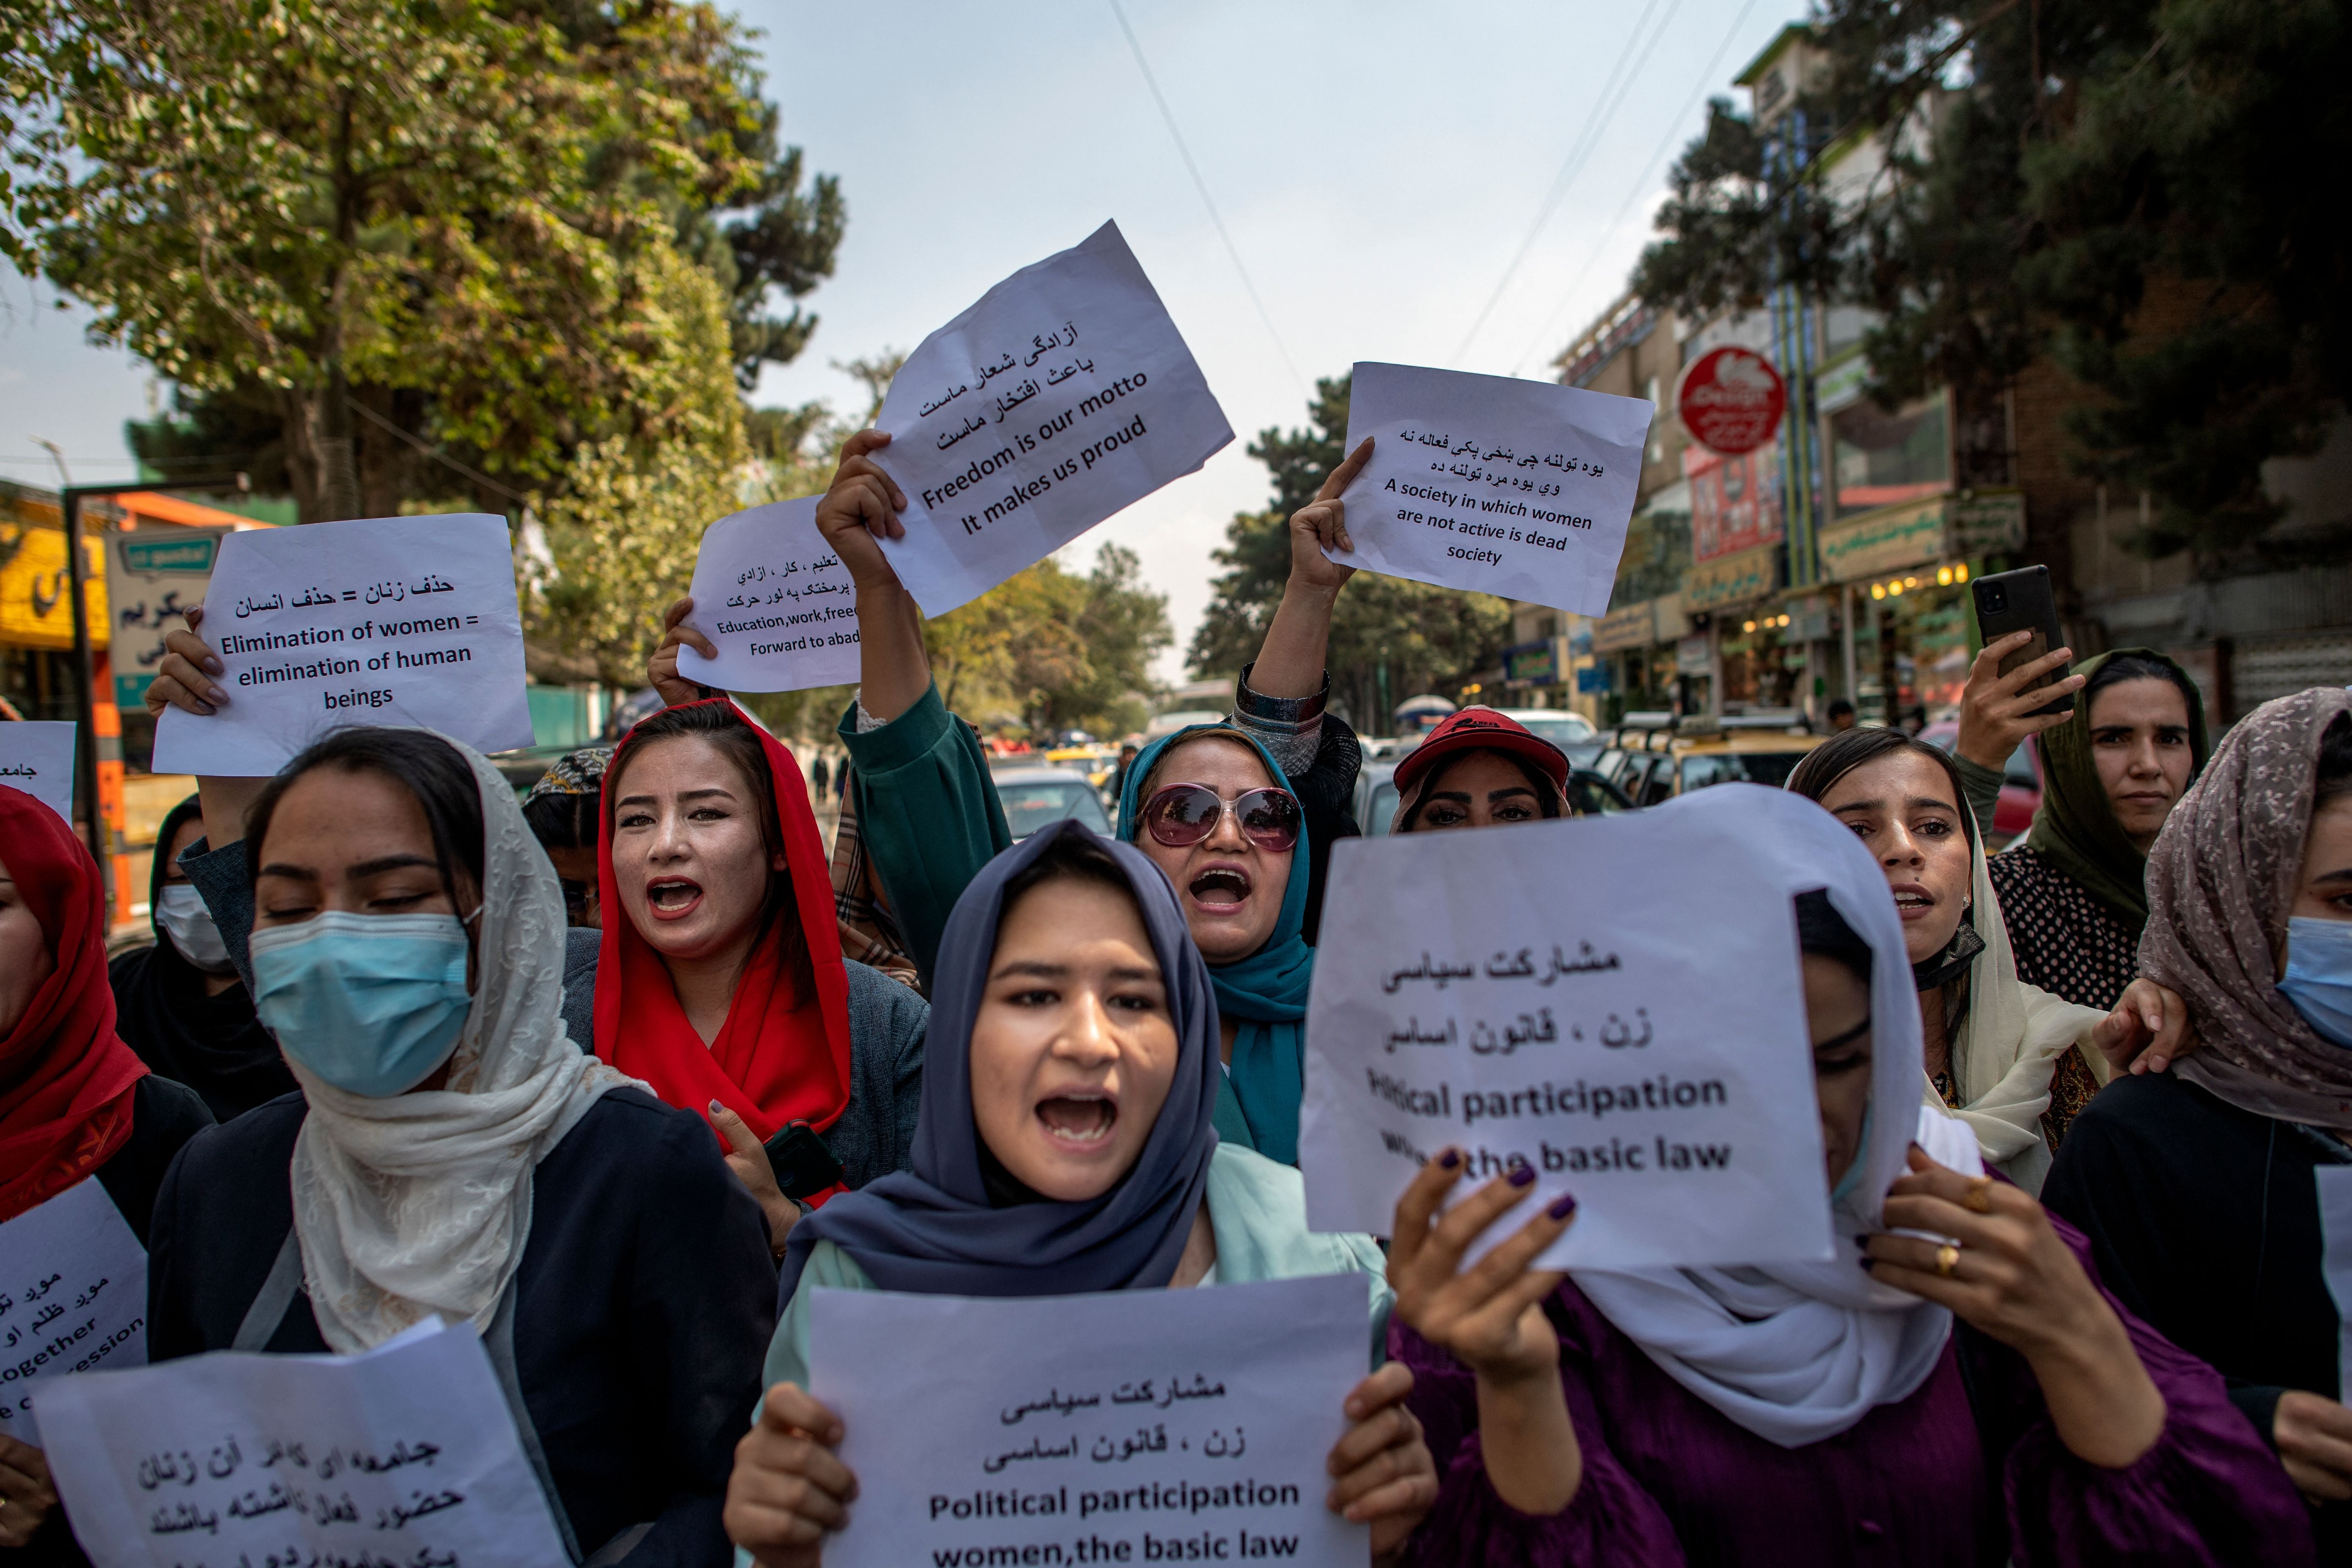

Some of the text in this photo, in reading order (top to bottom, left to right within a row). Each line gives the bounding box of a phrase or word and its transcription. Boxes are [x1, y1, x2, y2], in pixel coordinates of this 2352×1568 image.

[976, 353, 1016, 390] شعار
[920, 385, 968, 417] ماست
[937, 359, 1094, 451] باعث افتخار ماست
[922, 373, 1147, 510] Freedom is our motto
[1400, 430, 1415, 442] نه
[1418, 433, 1448, 449] فعاله
[961, 414, 1147, 535] It makes us proud
[1431, 463, 1445, 472] ده
[1384, 478, 1592, 530] A society in which women
[1397, 509, 1568, 551] are not active is dead
[781, 561, 798, 577] کار
[1447, 547, 1503, 566] society
[291, 587, 336, 608] حذف
[365, 582, 404, 604] زنان
[411, 574, 454, 595] حذف
[727, 595, 760, 608] حرکت
[765, 588, 784, 604] لور
[787, 588, 800, 602] په
[236, 593, 283, 618] انسان
[221, 627, 344, 655] Elimination
[351, 621, 373, 640] of
[378, 616, 460, 637] women
[750, 636, 806, 656] Forward
[809, 637, 825, 648] to
[239, 648, 471, 686] elimination of human
[324, 689, 393, 710] beings
[1486, 943, 1621, 986] مشارکت
[1471, 1008, 1557, 1055] قانون
[1600, 1008, 1651, 1050] زن
[1462, 1076, 1729, 1124] participation
[1540, 1138, 1646, 1173] basic
[1655, 1135, 1733, 1171] law
[5, 1326, 22, 1347] او
[32, 1304, 65, 1336] ظلم
[1001, 1374, 1226, 1426] مشارکت سیاسی
[1091, 1424, 1168, 1463] قانون
[1203, 1427, 1245, 1459] زن
[138, 1450, 199, 1491] زنان
[374, 1489, 466, 1531] حضور
[930, 1479, 1299, 1520] Political participation
[933, 1530, 1299, 1568] women,the basic law
